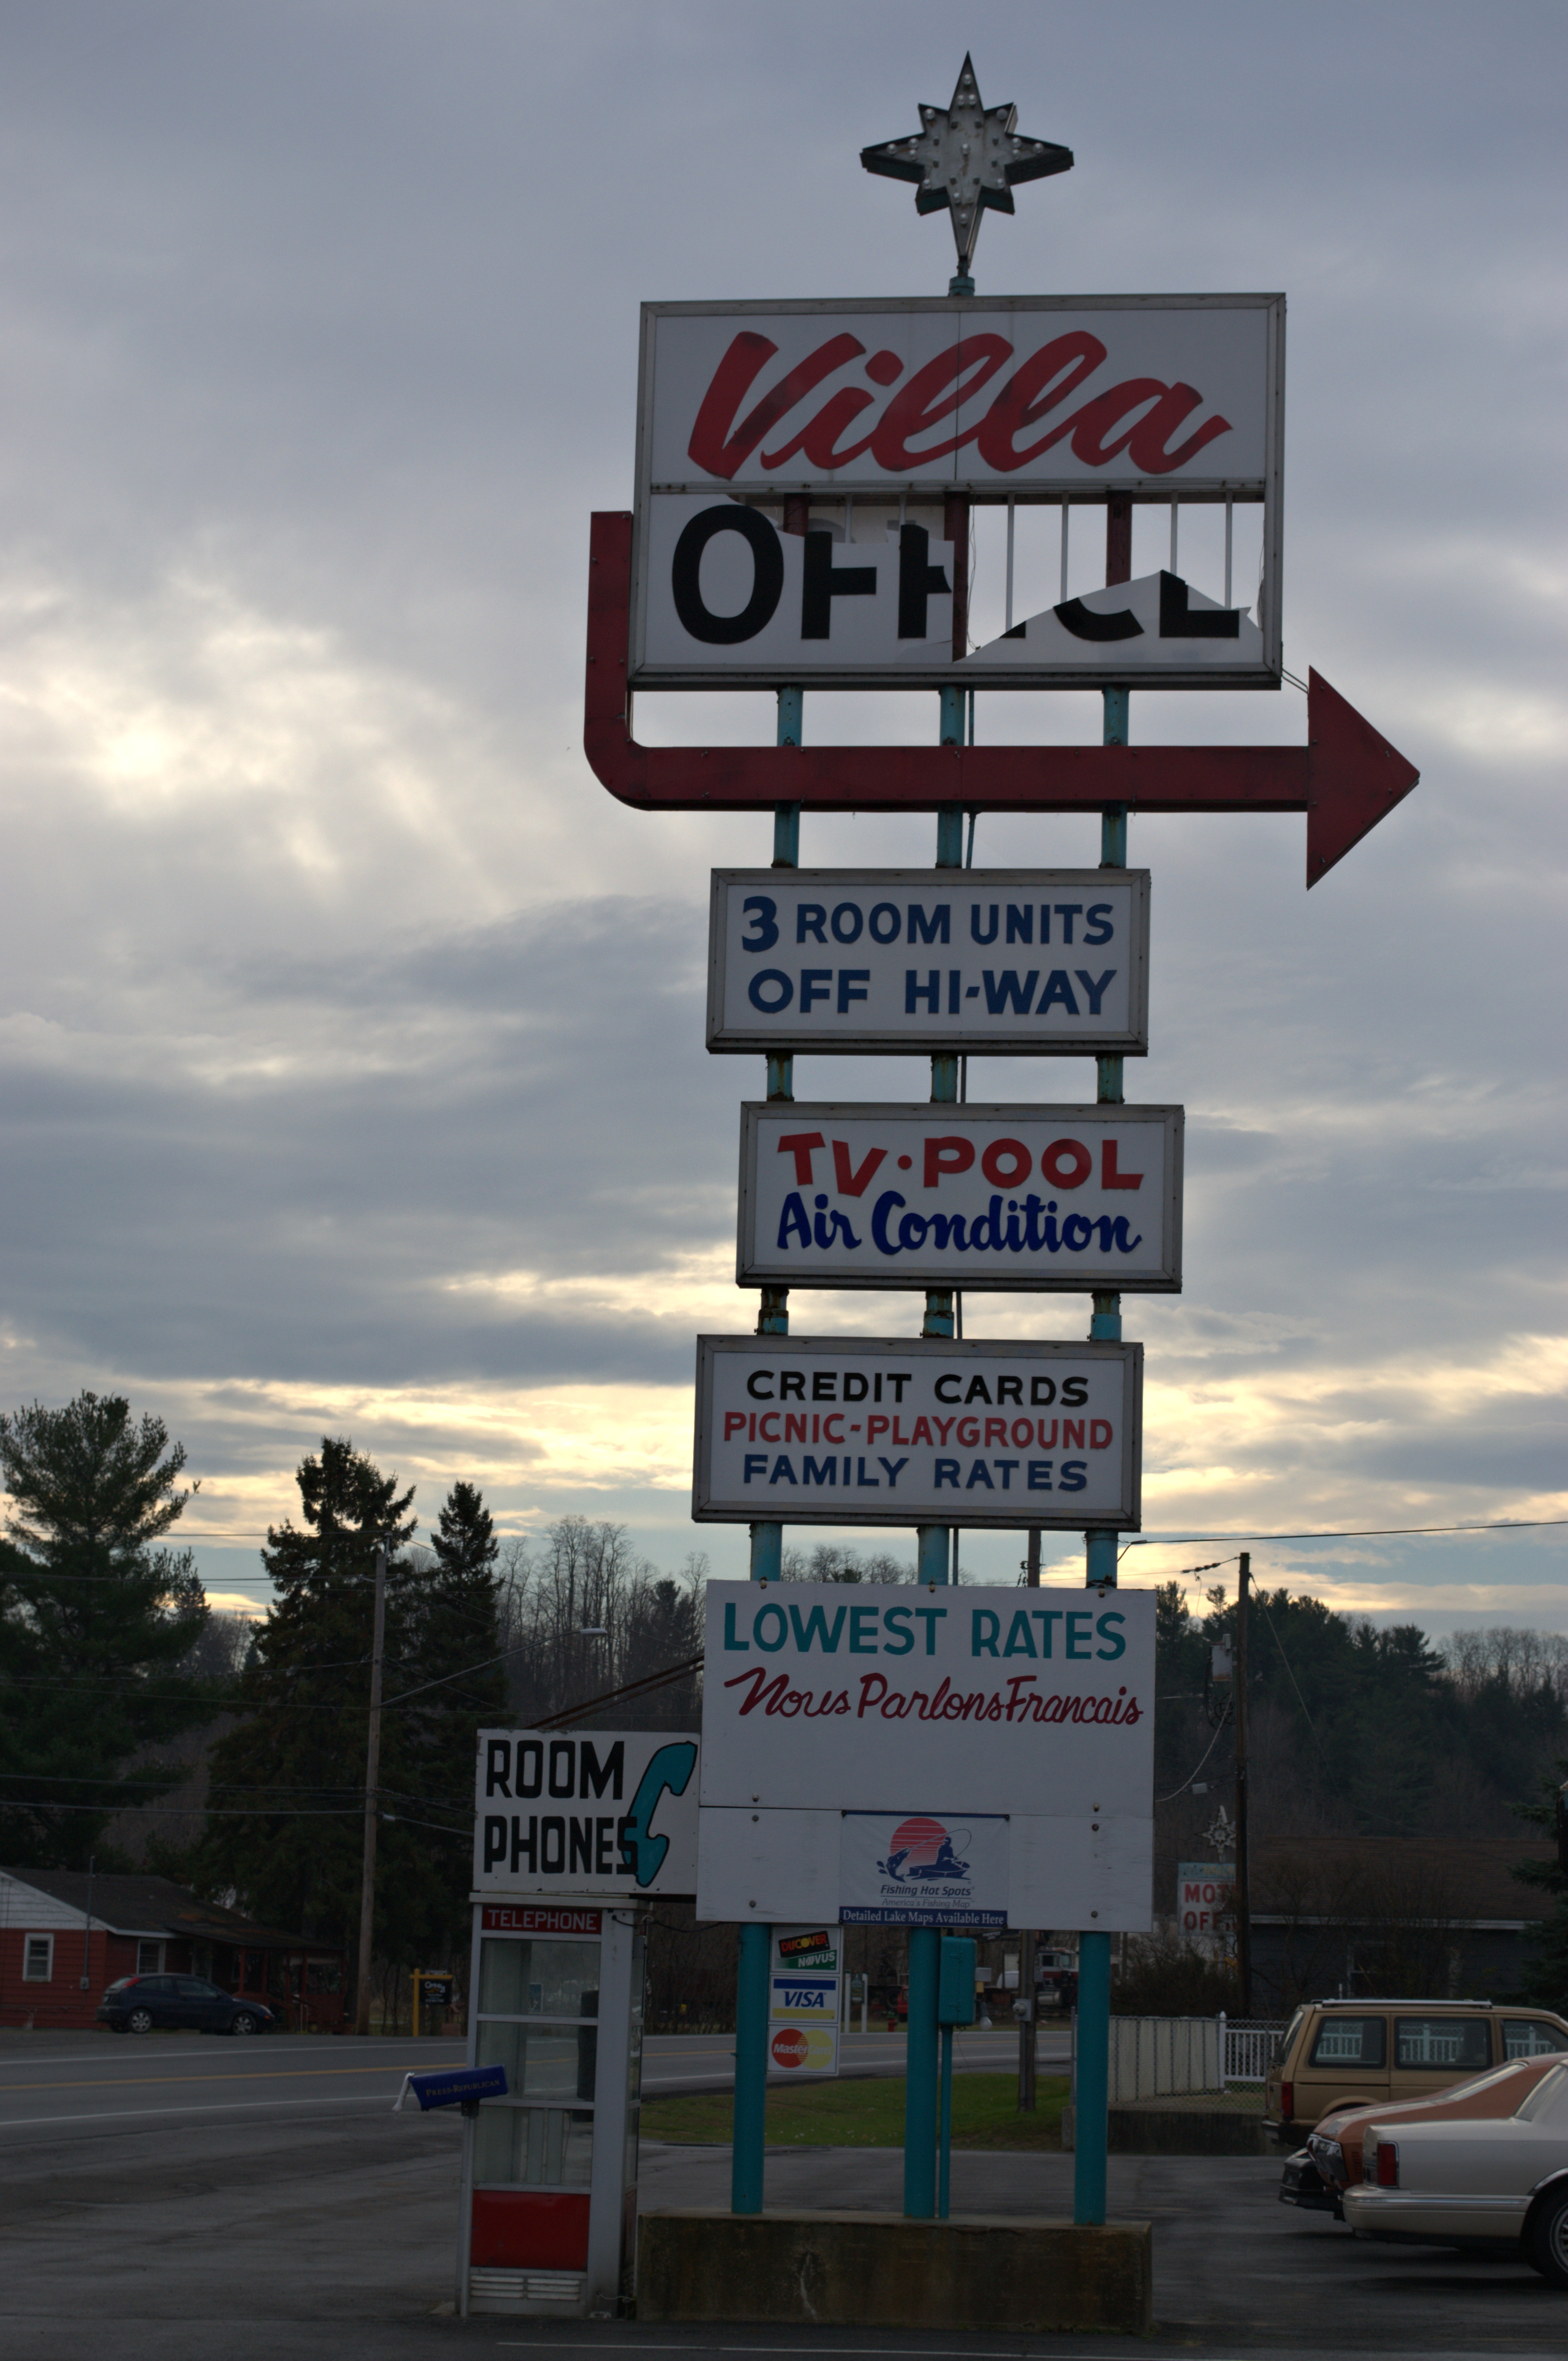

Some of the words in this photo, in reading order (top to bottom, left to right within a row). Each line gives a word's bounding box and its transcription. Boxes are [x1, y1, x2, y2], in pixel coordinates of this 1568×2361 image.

[688, 330, 1232, 479] Villa
[742, 896, 779, 953] 3
[796, 902, 951, 945] ROOM
[971, 903, 1114, 945] UNITS
[748, 968, 870, 1013] OFF
[904, 970, 1118, 1015] HI-WAY
[777, 1191, 862, 1249] Air
[871, 1190, 1142, 1255] Condition
[746, 1370, 912, 1403] CREDIT
[934, 1374, 1089, 1407] CARDS
[724, 1411, 1113, 1450] PICNIC-PLAYGROUND
[744, 1454, 909, 1488] FAMILY
[934, 1458, 1088, 1492] RATES
[724, 1602, 948, 1656] LOWEST
[972, 1609, 1127, 1661] RATES
[723, 1667, 852, 1718] Nous
[858, 1672, 1007, 1722] Parlons
[1006, 1675, 1144, 1726] Francais
[486, 1739, 624, 1800] ROOM
[484, 1815, 638, 1875] PHONES
[880, 1885, 918, 1896] Fishing
[920, 1886, 940, 1896] Hot
[942, 1886, 972, 1897] Spots
[881, 1898, 921, 1906] America's
[922, 1899, 950, 1909] Fishing
[952, 1900, 971, 1910] Map
[1184, 1883, 1236, 1904] MOT
[488, 1909, 598, 1930] TELEPHONE
[843, 1910, 882, 1922] Detailed
[884, 1911, 906, 1922] Lake
[908, 1912, 933, 1925] Maps
[936, 1912, 979, 1924] Available
[981, 1913, 1004, 1924] Here
[780, 1933, 828, 1953] DISCOVER
[798, 1951, 835, 1969] NOVUS
[783, 1991, 824, 2008] VISA
[773, 2043, 833, 2056] MasterCard
